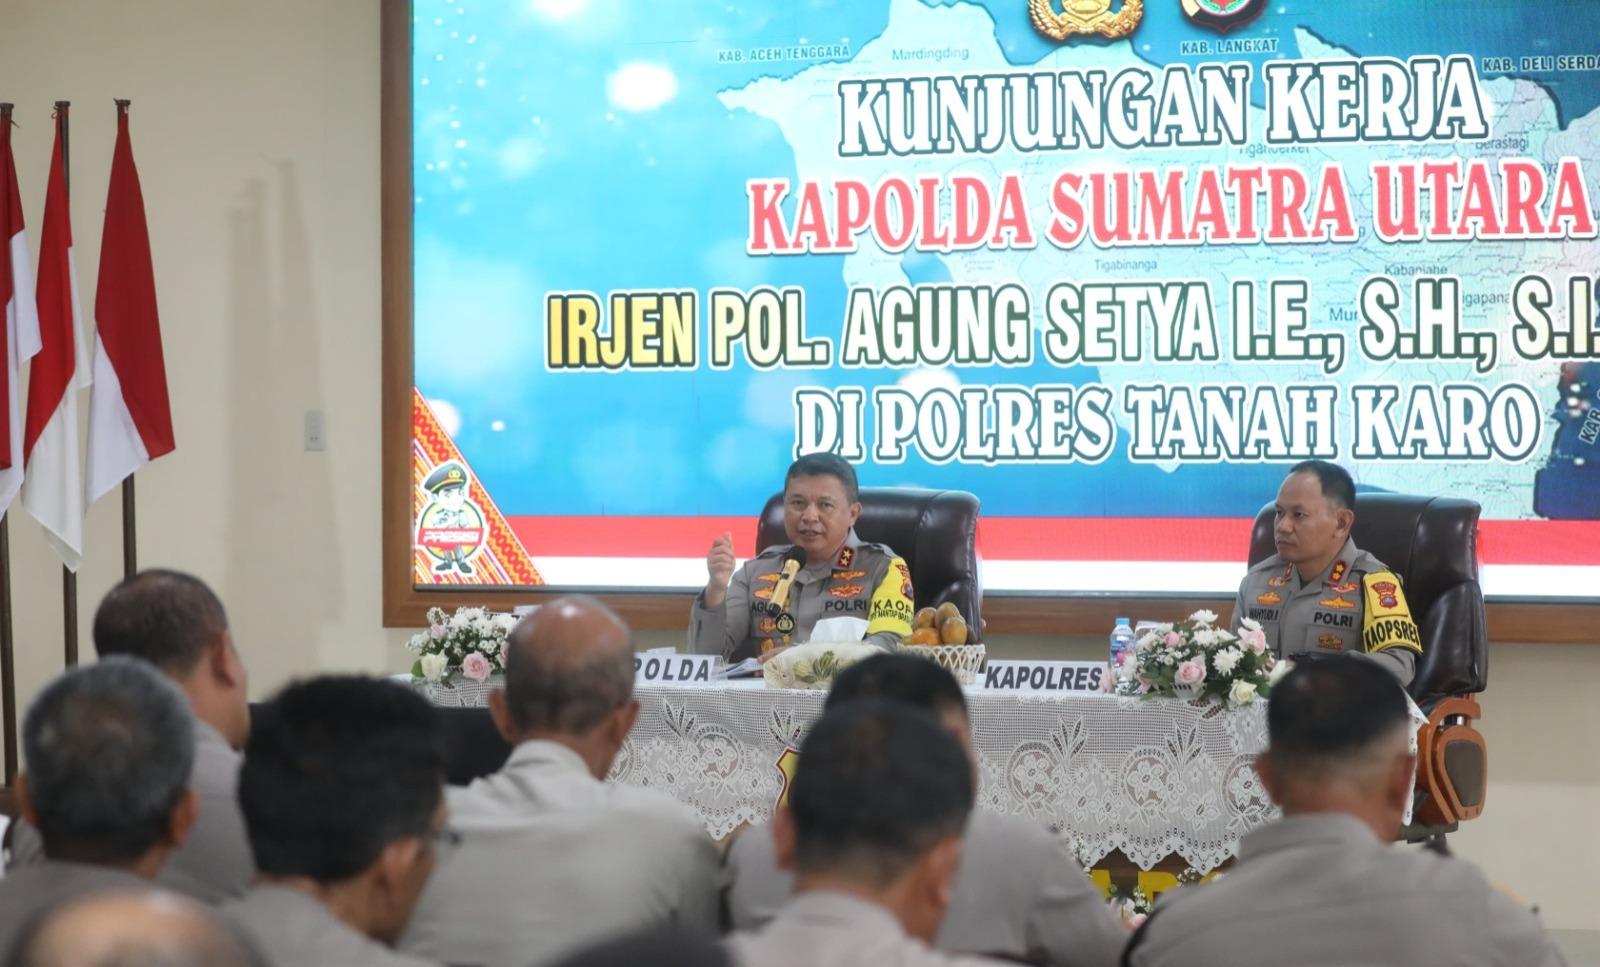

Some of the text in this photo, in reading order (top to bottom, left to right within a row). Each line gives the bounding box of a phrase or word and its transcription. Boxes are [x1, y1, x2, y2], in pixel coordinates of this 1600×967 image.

[718, 46, 850, 62] KAB. ACEH TENGGARA
[892, 47, 970, 62] Mardingding
[1182, 39, 1278, 54] KAB. LANGKAT
[1483, 58, 1516, 71] KAB.
[1522, 57, 1553, 70] DELI
[838, 57, 1489, 156] KUNJUNGAN KERJA
[748, 159, 1595, 253] KAPOLDA SUMATRA UTARA
[1094, 258, 1158, 273] Tigabinanga
[547, 292, 695, 369] IRJEN
[712, 288, 830, 367] POL.
[842, 284, 1032, 366] AGUNG
[1043, 281, 1219, 364] SETYA
[1232, 279, 1345, 374] I.E.,
[1359, 276, 1497, 374] S.H.,
[796, 383, 1541, 463] DI POLRES TANAH KARO
[824, 600, 868, 612] POLRI
[873, 598, 913, 616] KAOP
[1313, 612, 1353, 627] POLRI
[984, 665, 1103, 691] KAPOLRES
